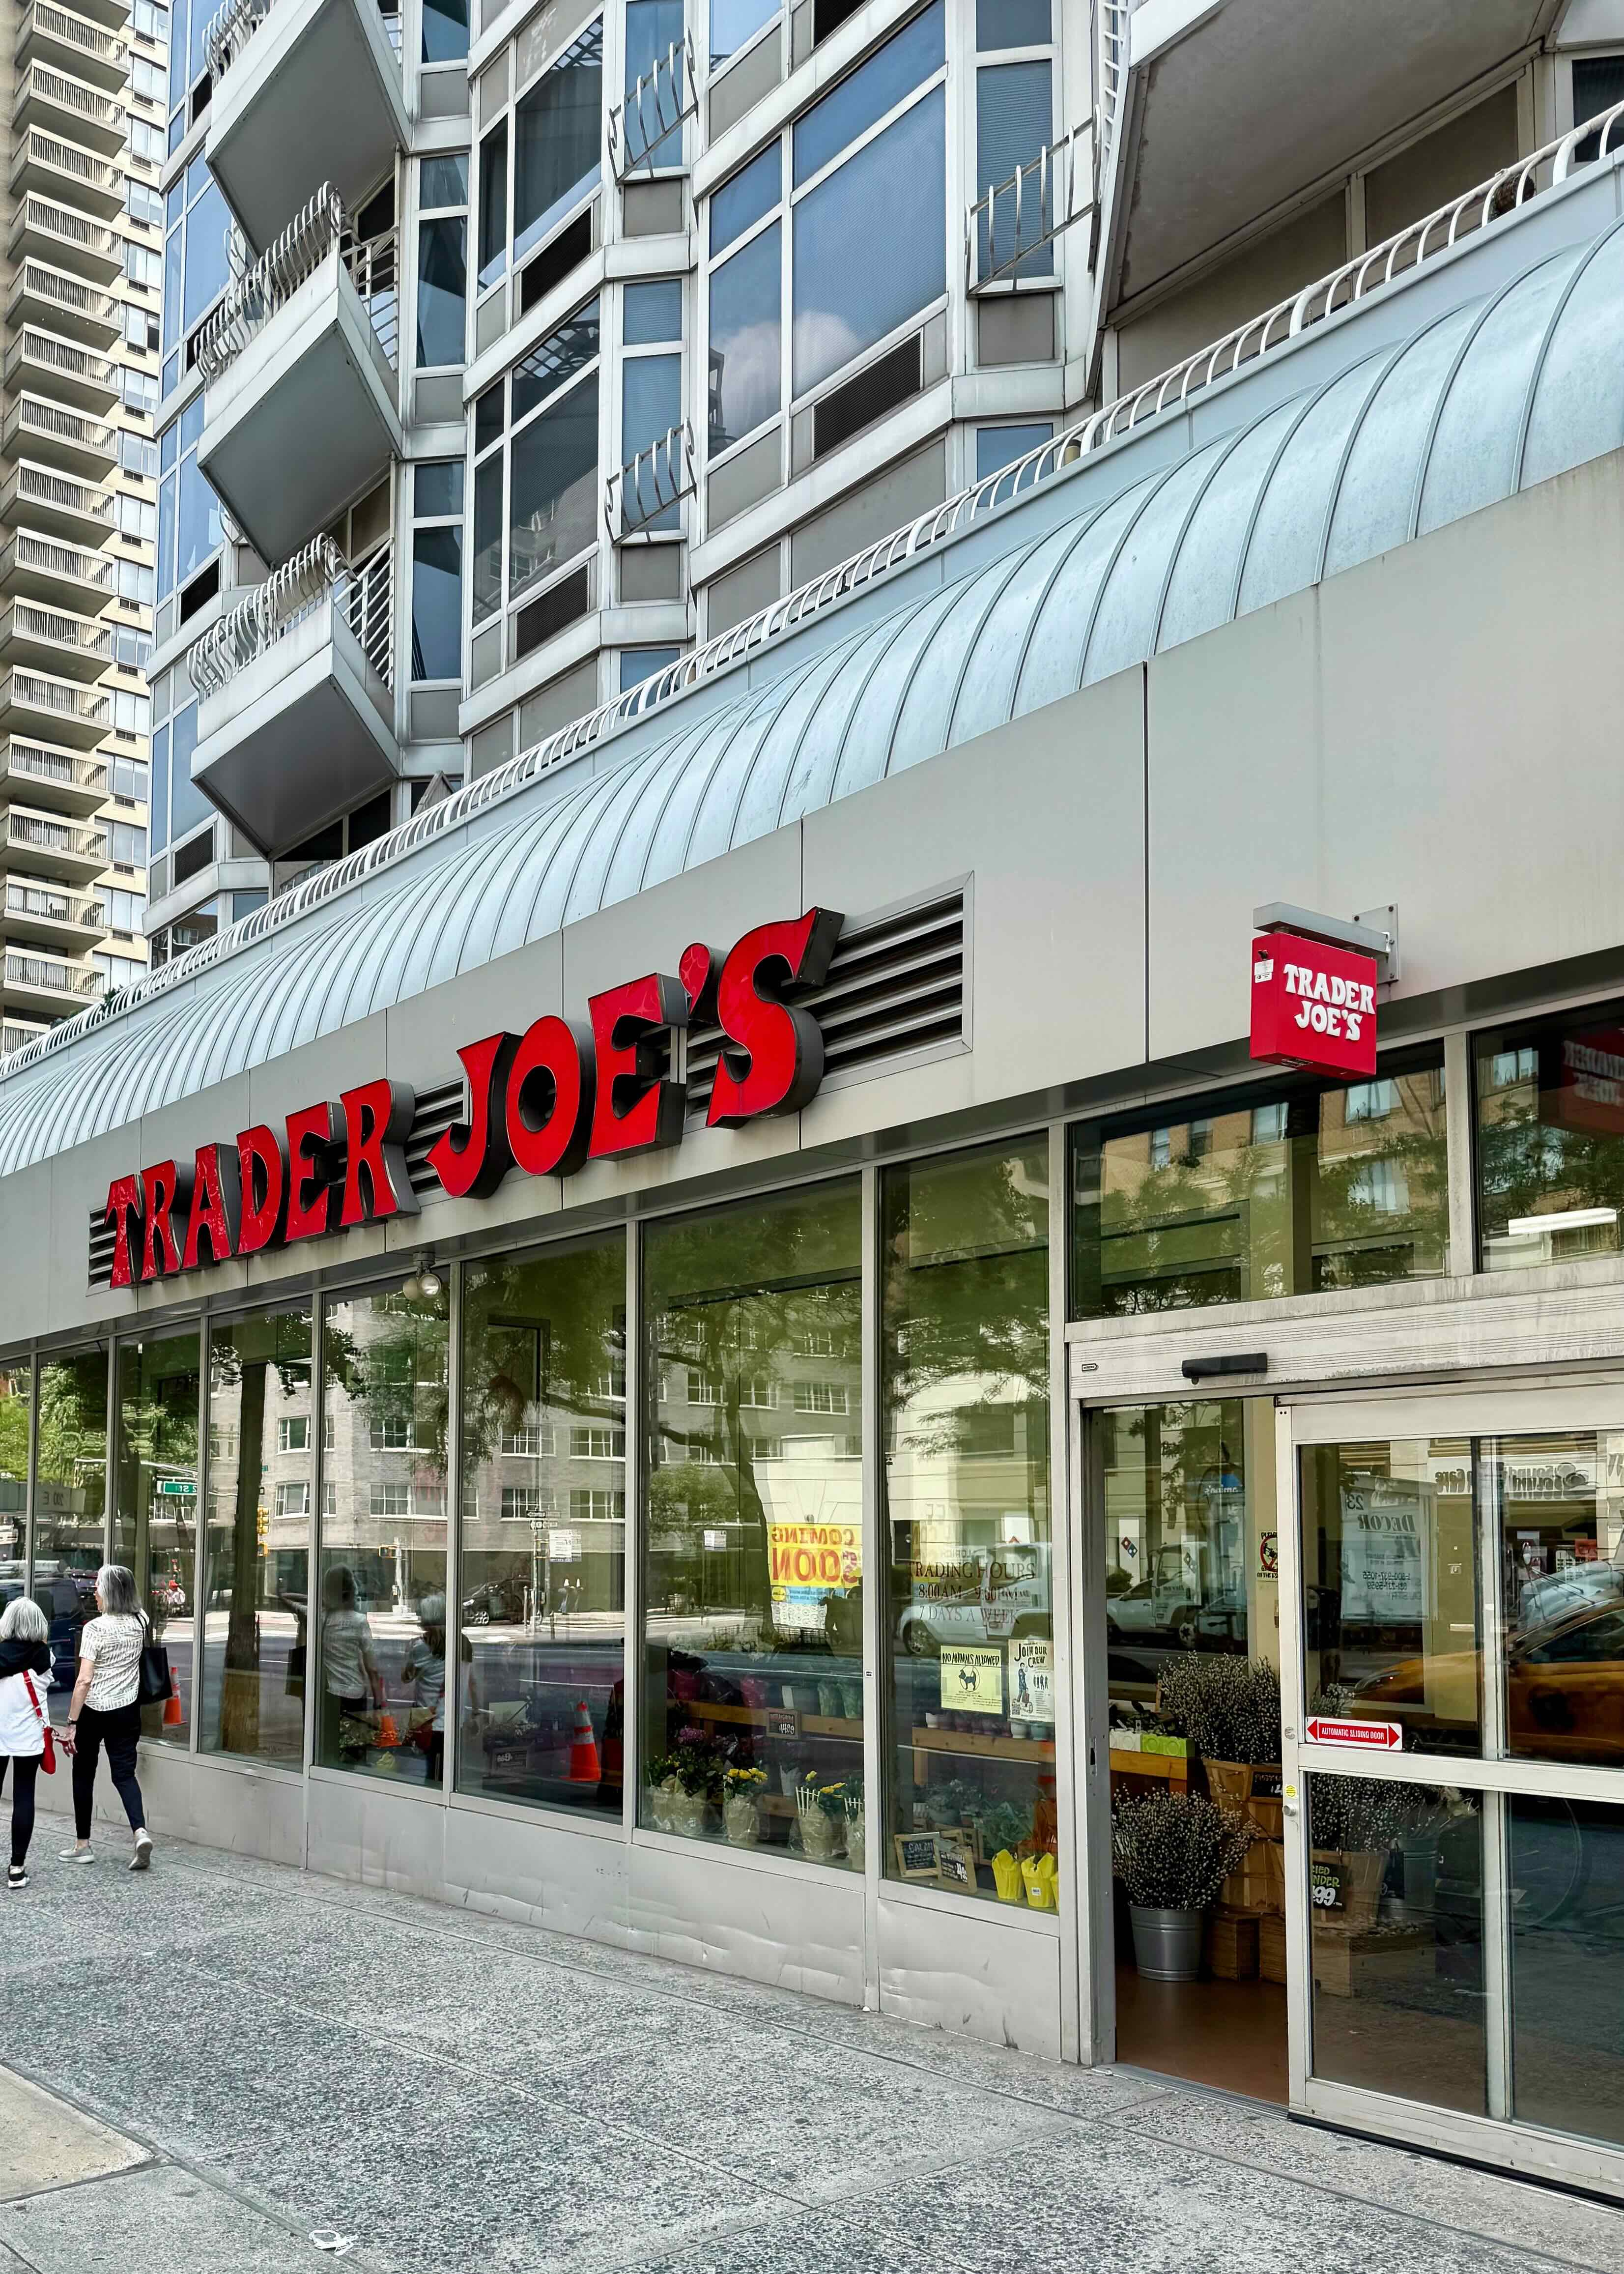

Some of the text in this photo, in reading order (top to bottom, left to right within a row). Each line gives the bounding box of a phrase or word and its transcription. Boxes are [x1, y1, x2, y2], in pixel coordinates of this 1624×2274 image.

[1283, 964, 1376, 1015] TRADER
[1294, 1000, 1363, 1041] JOE'S
[104, 906, 835, 1289] TRADER JOE'S
[909, 1561, 1035, 1579] TRADING HOURS
[919, 1606, 1022, 1624] 7 DAYS A WEEK
[942, 1652, 1000, 1667] NO ANIMALS ALLOWED
[1014, 1643, 1048, 1661] JOIN OUR
[1027, 1656, 1046, 1668] CREW
[1321, 1727, 1384, 1740] AUTOMATIC SLIDING DOOR
